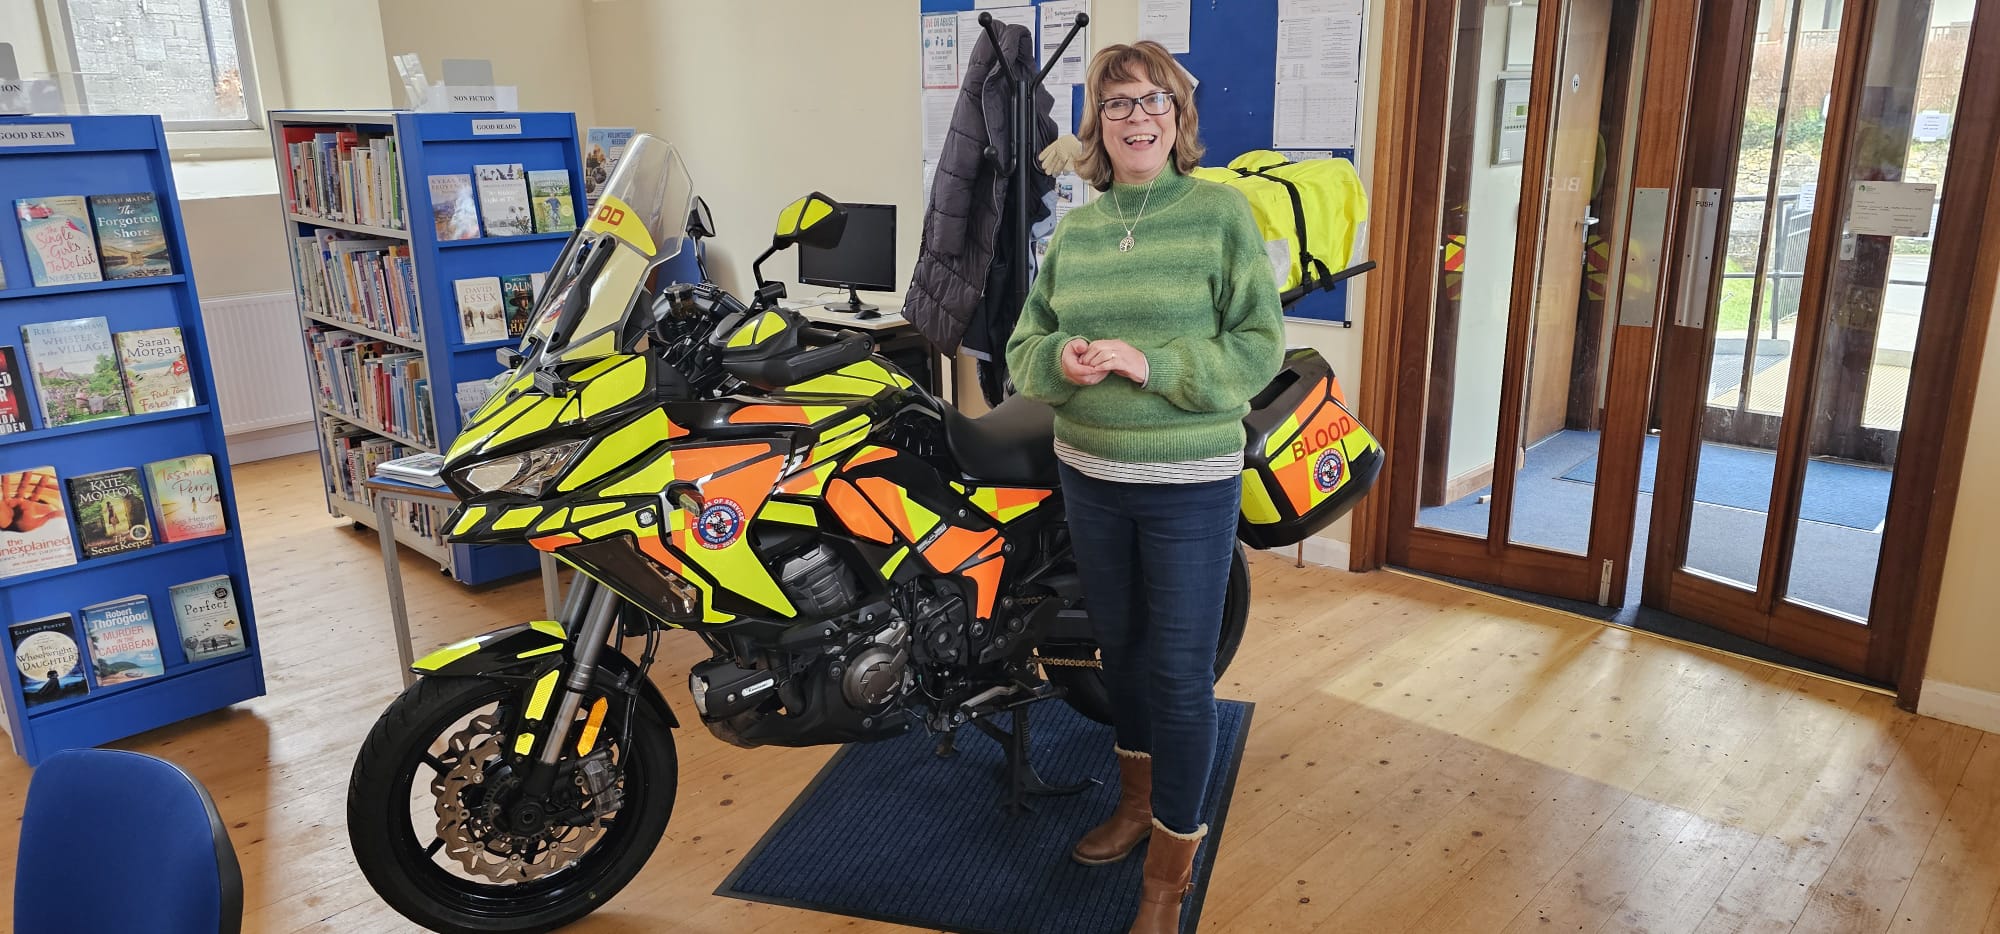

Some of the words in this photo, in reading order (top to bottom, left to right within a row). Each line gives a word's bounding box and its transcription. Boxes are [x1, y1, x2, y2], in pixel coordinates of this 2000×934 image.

[0, 84, 21, 92] ION
[0, 131, 28, 140] GOOD
[31, 130, 65, 139] READS
[118, 205, 136, 215] The
[597, 205, 625, 226] OD
[97, 215, 159, 228] Forgotten
[36, 228, 73, 249] Single
[113, 228, 150, 239] Shore
[465, 286, 493, 294] DAVID
[504, 282, 532, 292] PALIN
[464, 293, 497, 304] ESSEX
[57, 340, 110, 354] VILLAGE
[137, 337, 171, 348] Sarah
[126, 345, 182, 359] Morgan
[0, 373, 12, 387] ED
[1291, 415, 1351, 462] BLOOD
[89, 477, 125, 491] KATE
[79, 486, 138, 504] MORTON
[172, 480, 214, 504] Perry
[0, 536, 71, 557] nexplained
[7, 539, 23, 547] the
[91, 545, 119, 556] Secret
[118, 539, 151, 551] Keeper
[105, 608, 133, 619] Robert
[184, 600, 229, 615] Perfect
[91, 611, 149, 631] Thorogood
[102, 626, 145, 641] MURDER
[99, 638, 155, 657] CARIBBEAN
[22, 655, 75, 671] DAUGHTER
